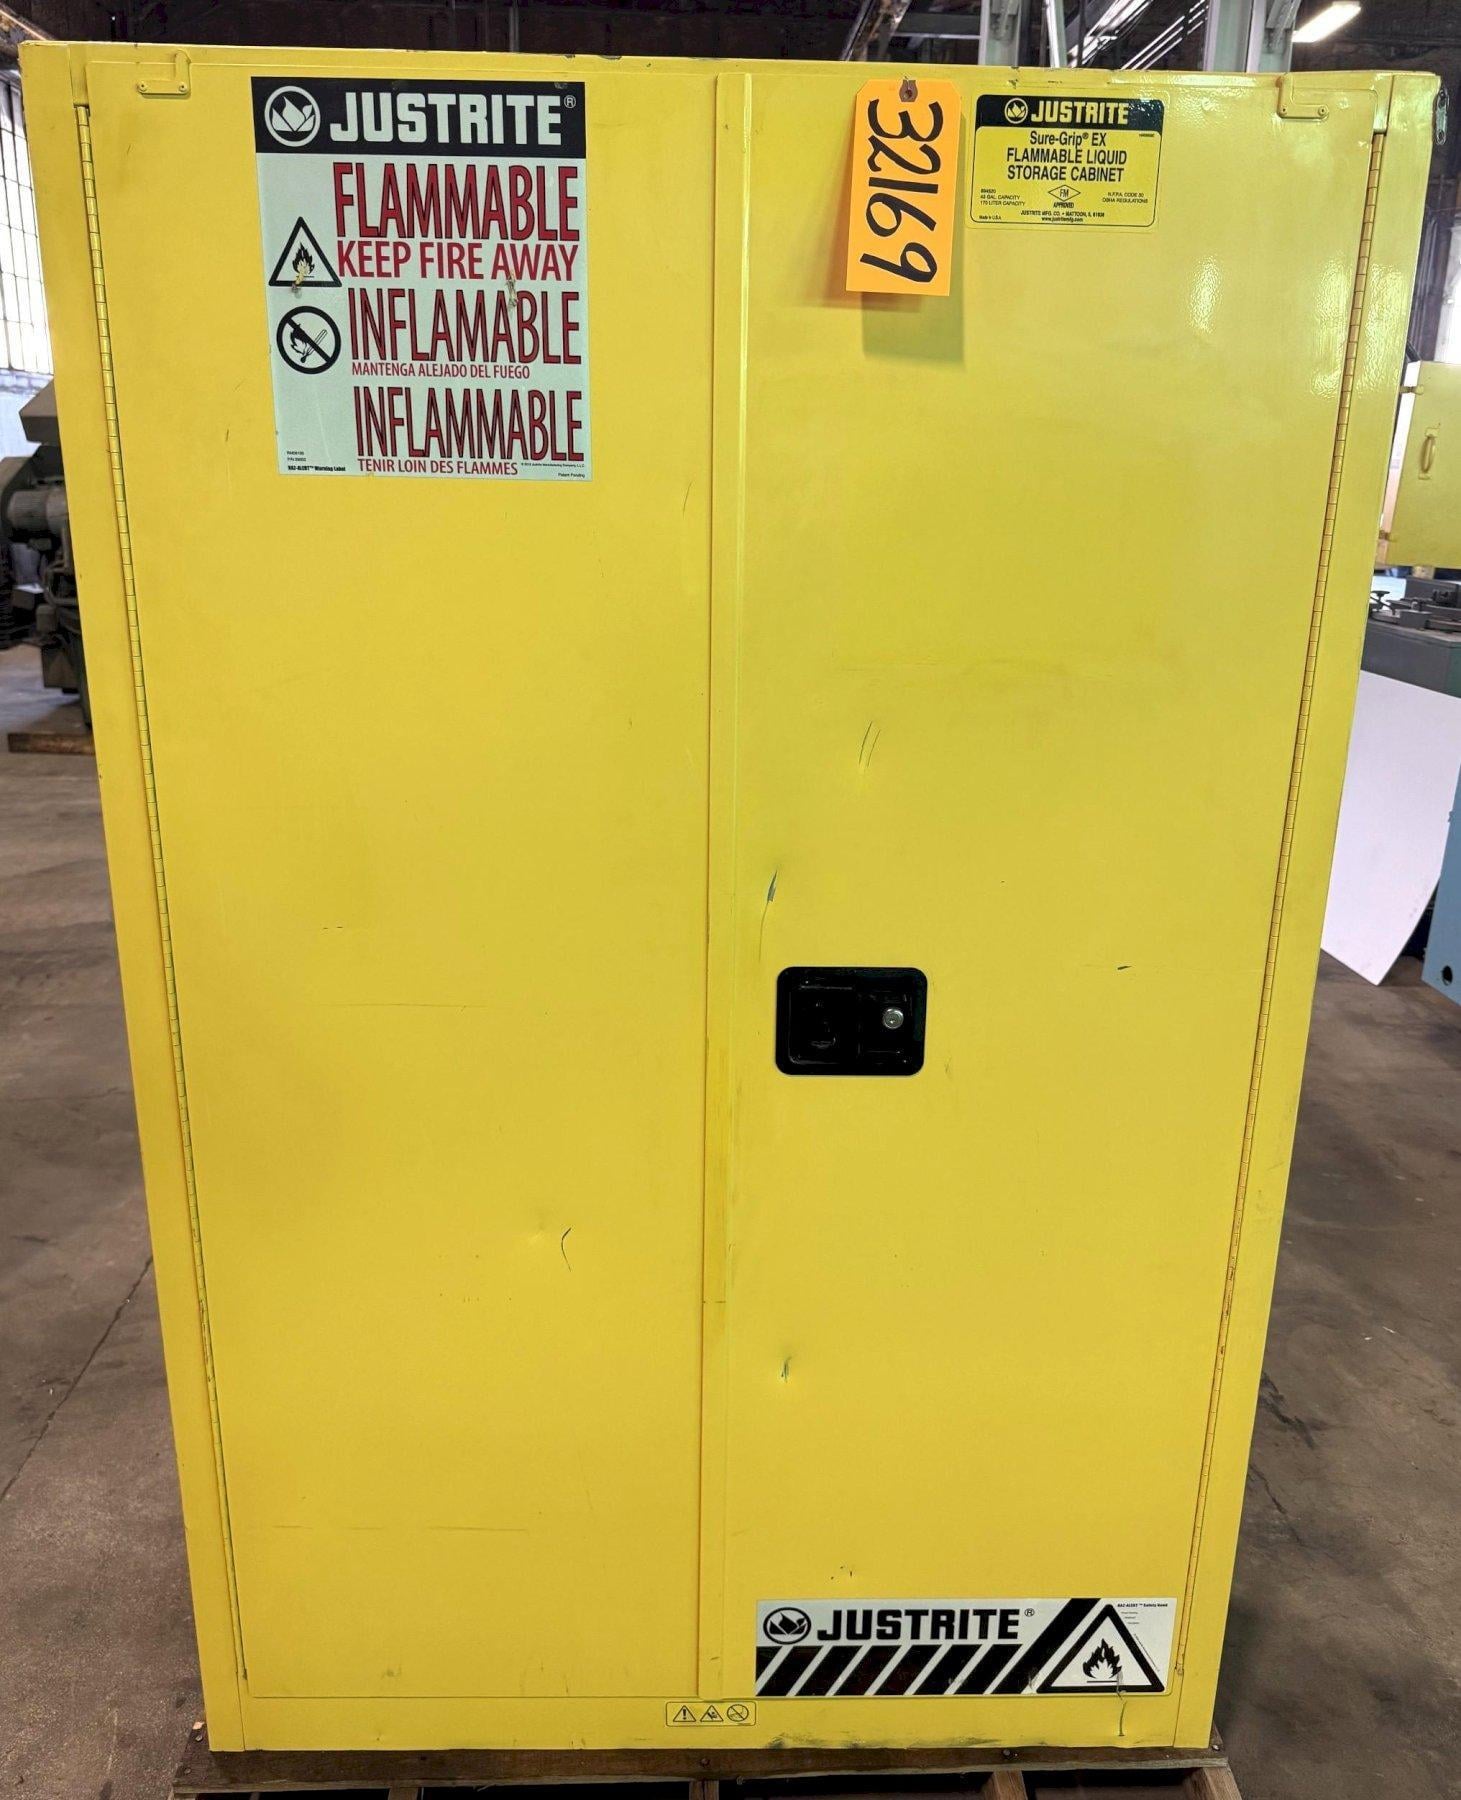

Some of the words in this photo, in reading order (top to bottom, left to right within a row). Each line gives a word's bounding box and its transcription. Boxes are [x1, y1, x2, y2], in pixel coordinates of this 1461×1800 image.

[1030, 100, 1129, 125] JUSTRITE
[1091, 132, 1107, 146] EX
[1007, 147, 1083, 164] FLAMMABLE
[1086, 150, 1127, 165] LIQUID
[1007, 165, 1067, 181] STORAGE
[1070, 166, 1124, 182] CABINET
[860, 98, 944, 283] 32169
[1060, 188, 1069, 198] FM
[332, 162, 580, 241] FLAMMABLE
[337, 240, 411, 278] KEEP
[419, 242, 484, 279] FIRE
[491, 243, 578, 281] AWAY
[347, 287, 581, 364] INFLAMABLE
[352, 362, 415, 377] MANTENGA
[418, 363, 467, 378] ALEJADO
[470, 364, 491, 378] DEL
[493, 365, 530, 379] FUEGO
[353, 386, 584, 462] INFLAMMABLE
[358, 458, 395, 472] TENIR
[398, 459, 427, 473] LOIN
[430, 460, 454, 474] DES
[457, 461, 518, 476] FLAMMES
